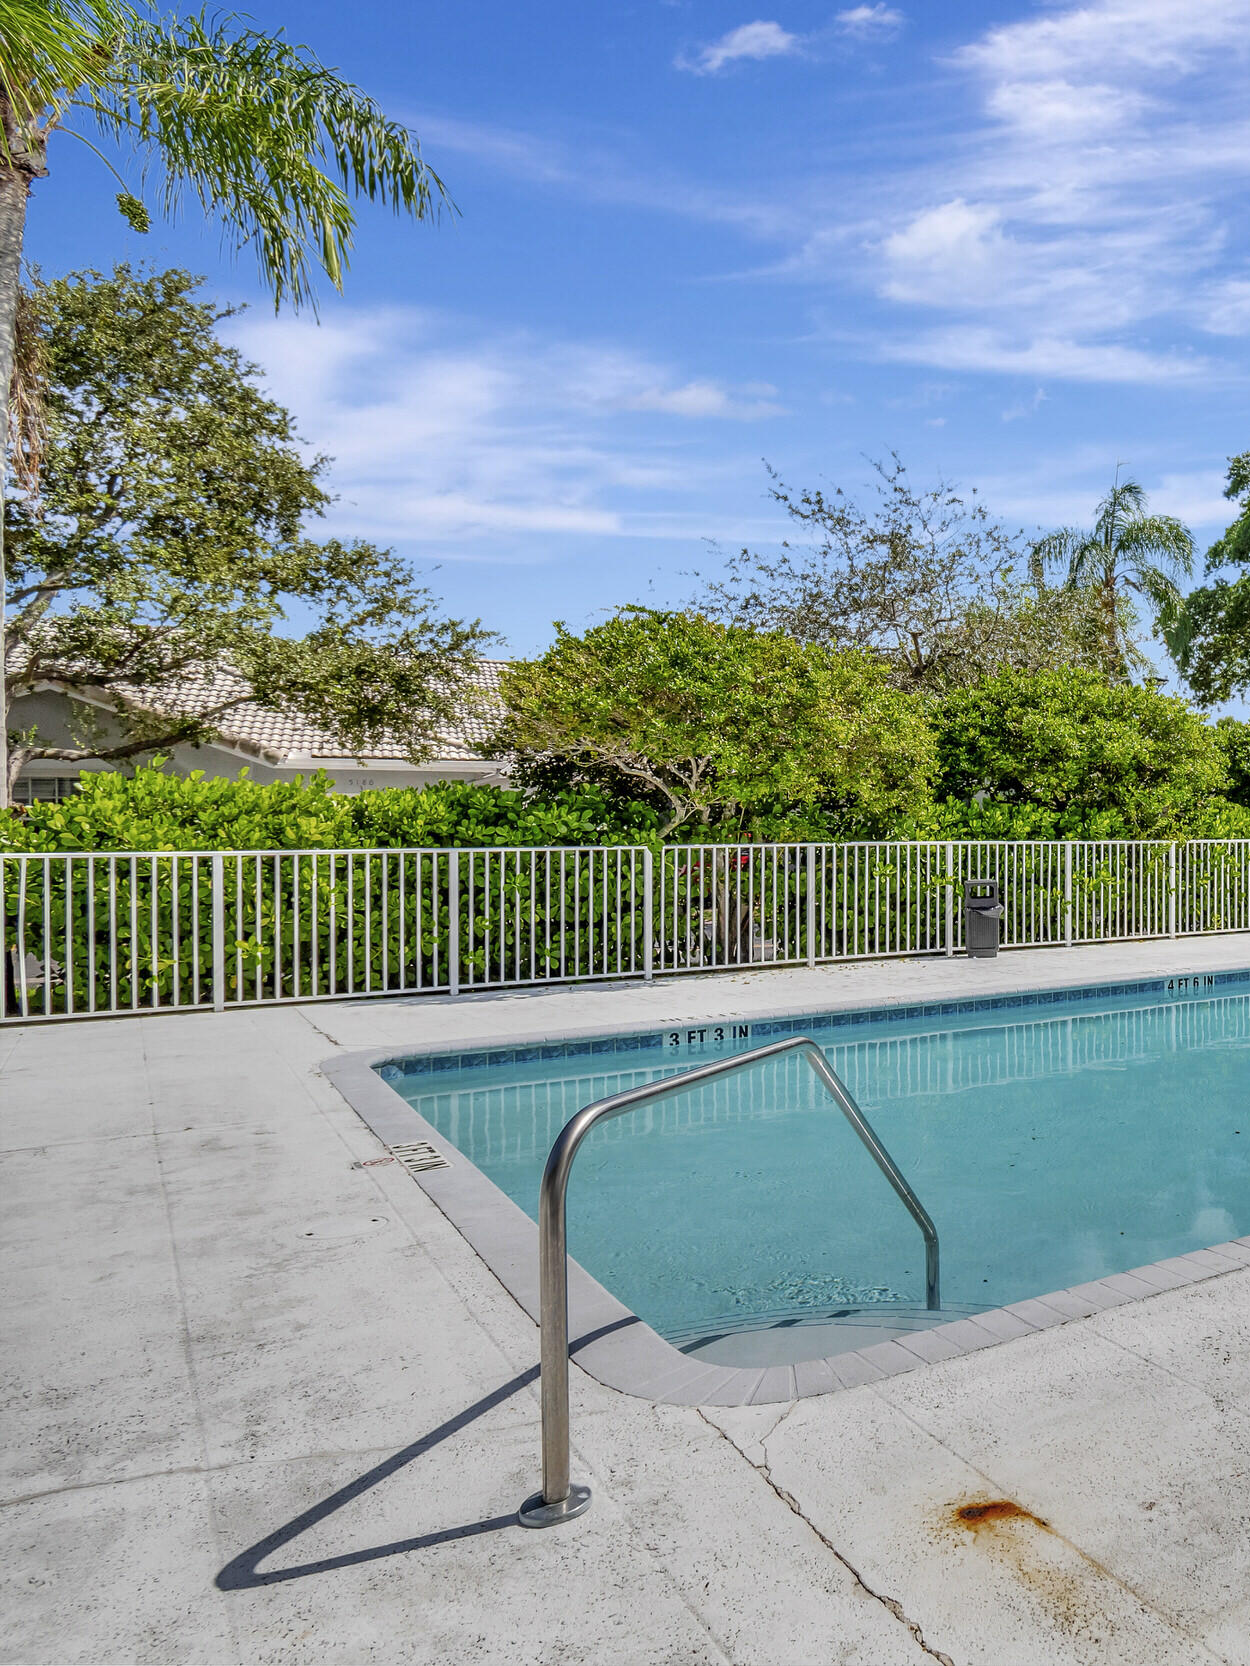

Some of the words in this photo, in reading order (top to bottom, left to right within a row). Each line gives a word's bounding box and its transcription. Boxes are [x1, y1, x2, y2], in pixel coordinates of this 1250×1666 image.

[1168, 979, 1174, 989] 4
[1178, 978, 1189, 989] FT
[1193, 976, 1199, 987] 6
[1203, 975, 1214, 986] IN
[669, 1032, 680, 1046] 3
[687, 1029, 707, 1044] FT
[714, 1027, 724, 1041] 3
[732, 1025, 749, 1039] IN
